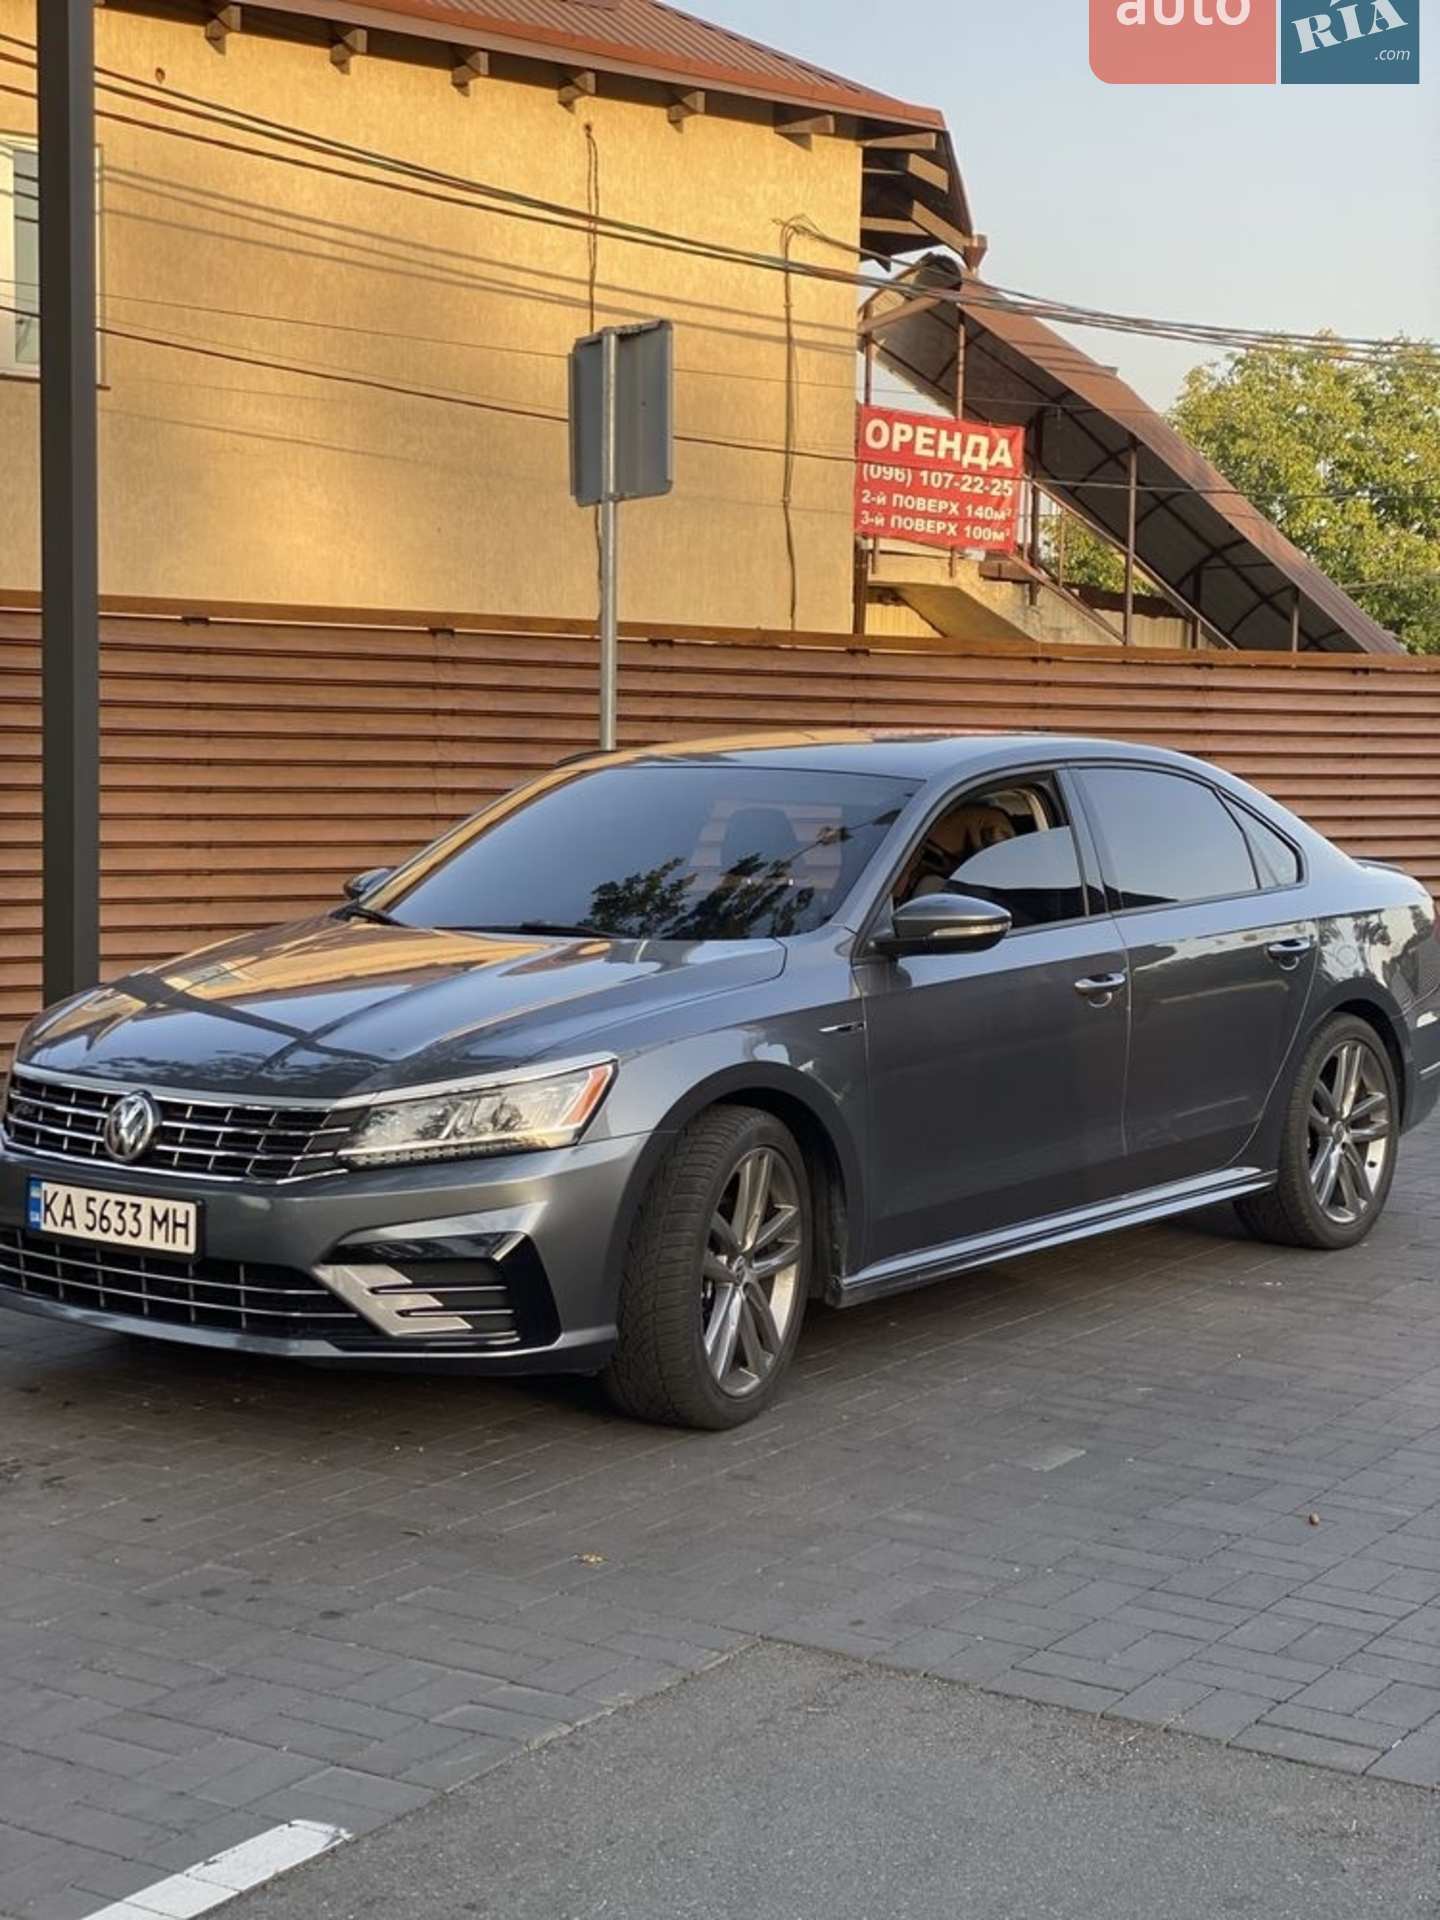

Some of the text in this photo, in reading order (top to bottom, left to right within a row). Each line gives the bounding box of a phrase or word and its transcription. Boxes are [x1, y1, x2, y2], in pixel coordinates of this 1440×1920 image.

[865, 418, 1014, 471] ОРЕНДА
[862, 463, 1014, 497] (096) 107-22-25
[861, 489, 888, 505] 2-й
[892, 493, 959, 516] ПОВЕРХ
[860, 510, 886, 527] 3-й
[890, 515, 958, 537] ПОВЕРХ
[43, 1189, 190, 1246] KA 5633 MH
